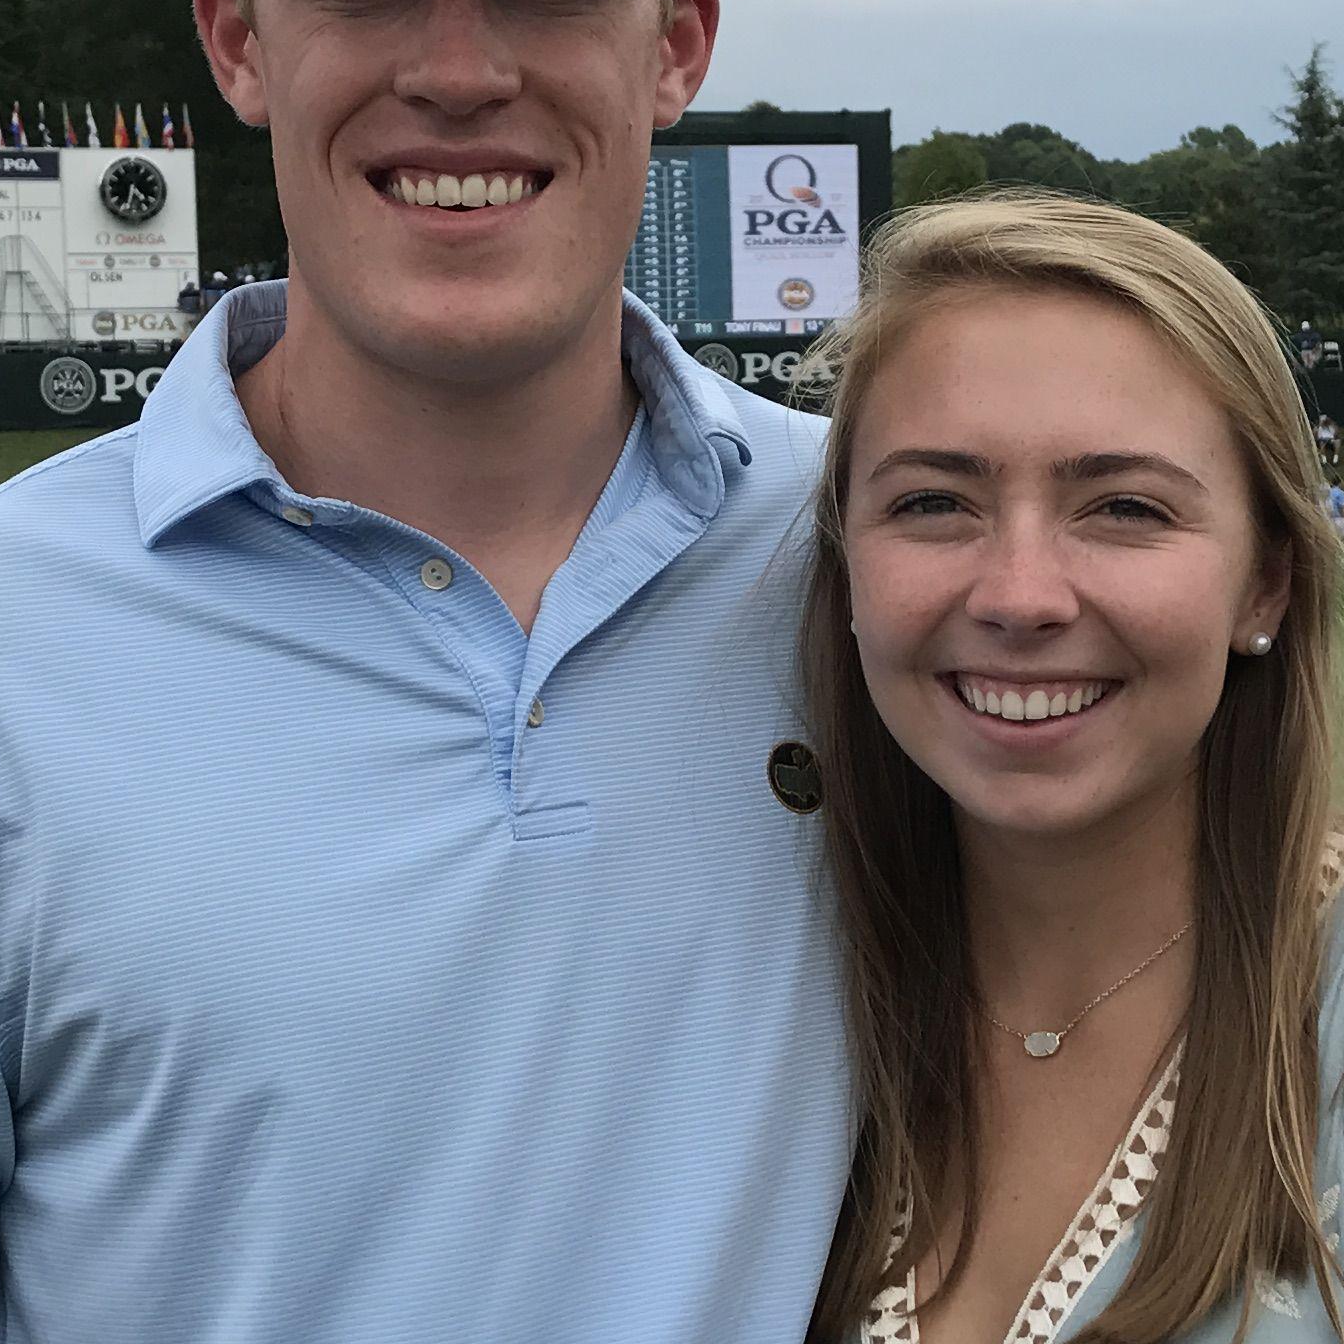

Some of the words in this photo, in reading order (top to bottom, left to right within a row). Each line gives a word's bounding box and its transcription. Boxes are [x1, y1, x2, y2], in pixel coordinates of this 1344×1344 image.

[4, 158, 40, 172] PGA
[743, 209, 846, 235] PGA
[115, 233, 165, 245] OMEGA
[743, 237, 846, 246] CHAMPIONSHIP
[121, 314, 176, 332] PGA
